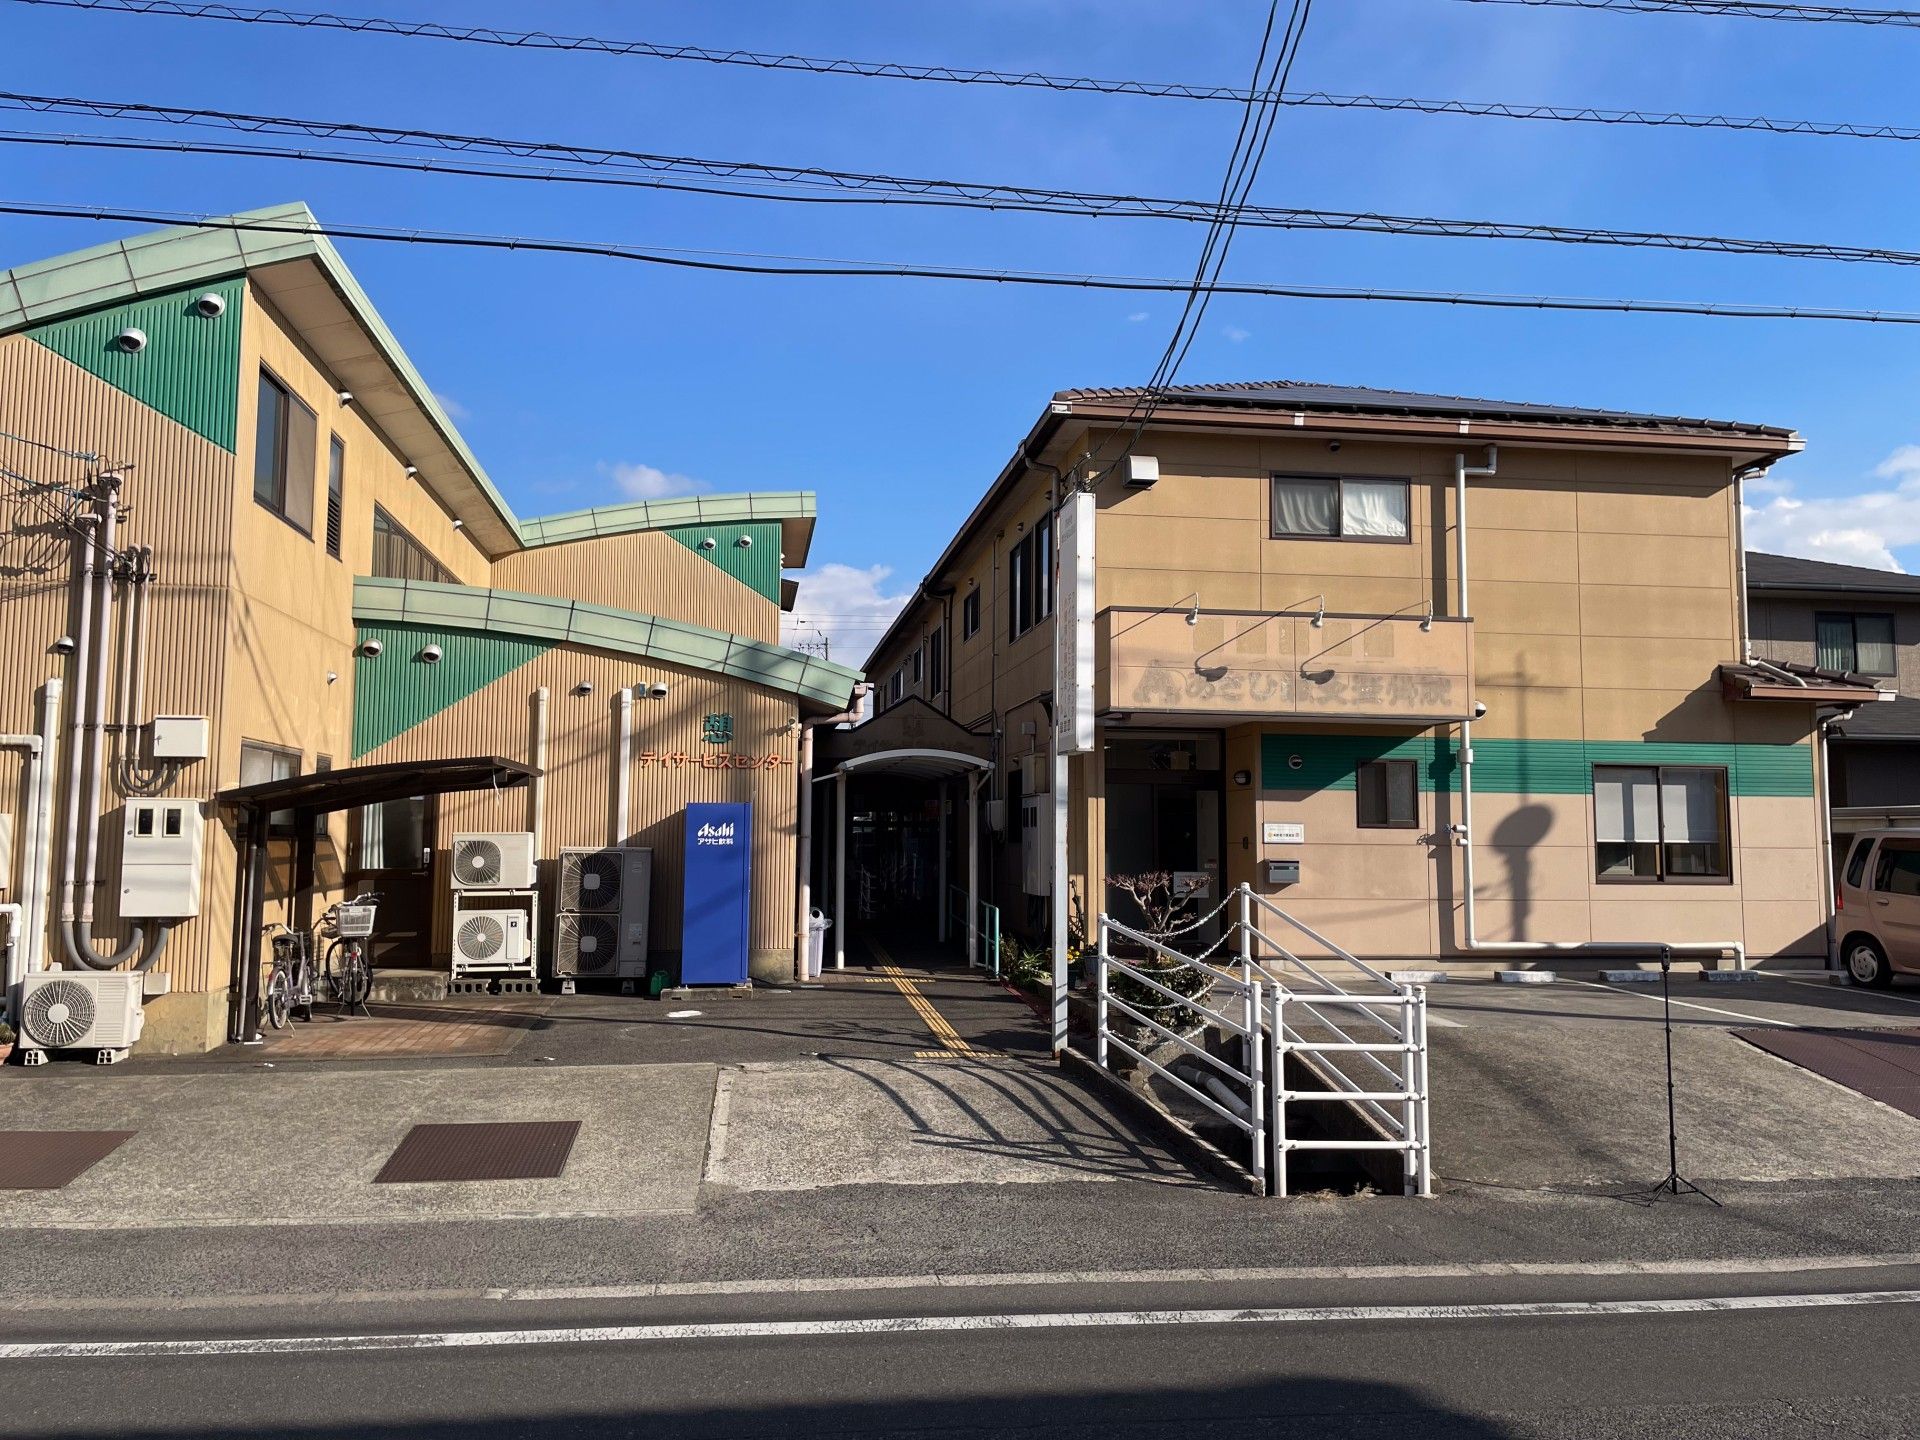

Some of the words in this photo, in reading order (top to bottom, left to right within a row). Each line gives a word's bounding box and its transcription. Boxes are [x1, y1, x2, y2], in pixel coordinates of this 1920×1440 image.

[640, 751, 795, 769] デイサービスセンター
[697, 822, 734, 837] Asahi
[697, 837, 734, 846] アサヒ飲料
